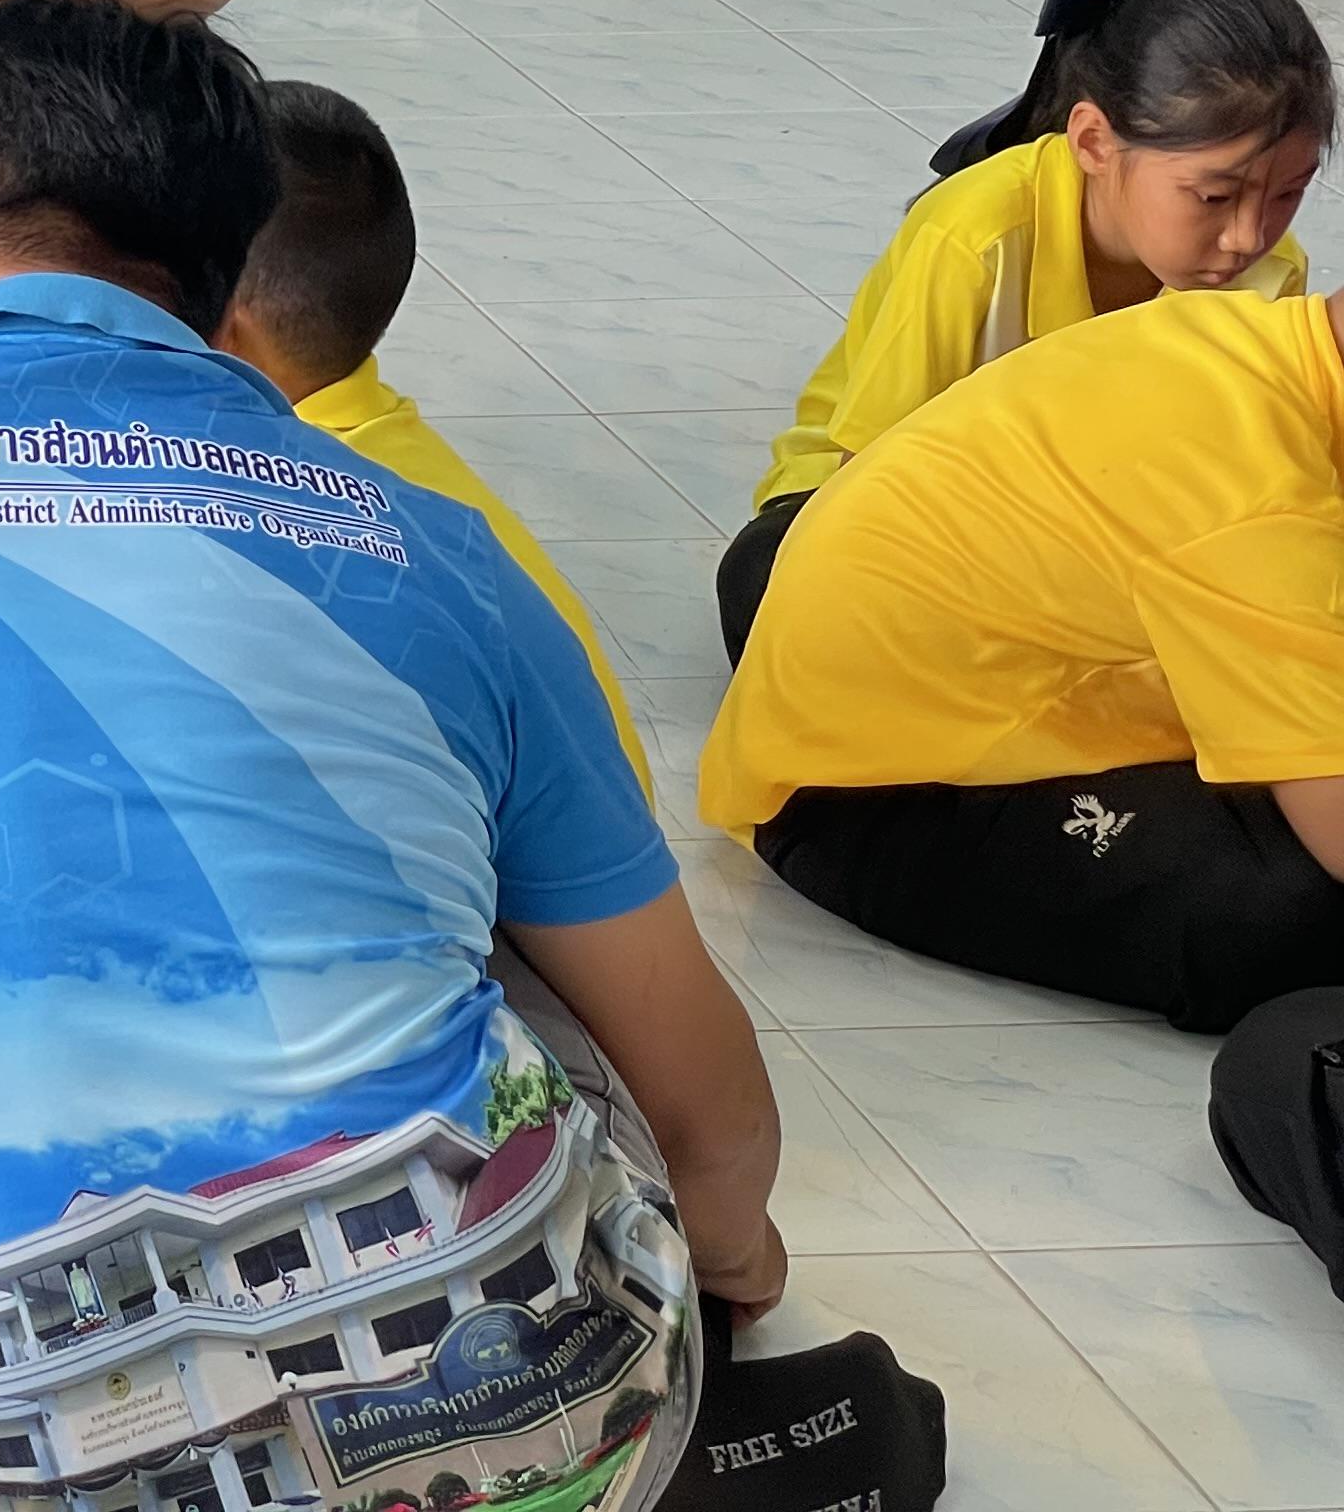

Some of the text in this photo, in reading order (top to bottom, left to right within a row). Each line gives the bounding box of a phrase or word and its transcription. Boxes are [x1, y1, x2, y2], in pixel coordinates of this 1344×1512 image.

[69, 497, 252, 530] Administrative
[261, 513, 406, 565] Organization
[708, 1397, 858, 1474] FREE SIZE
